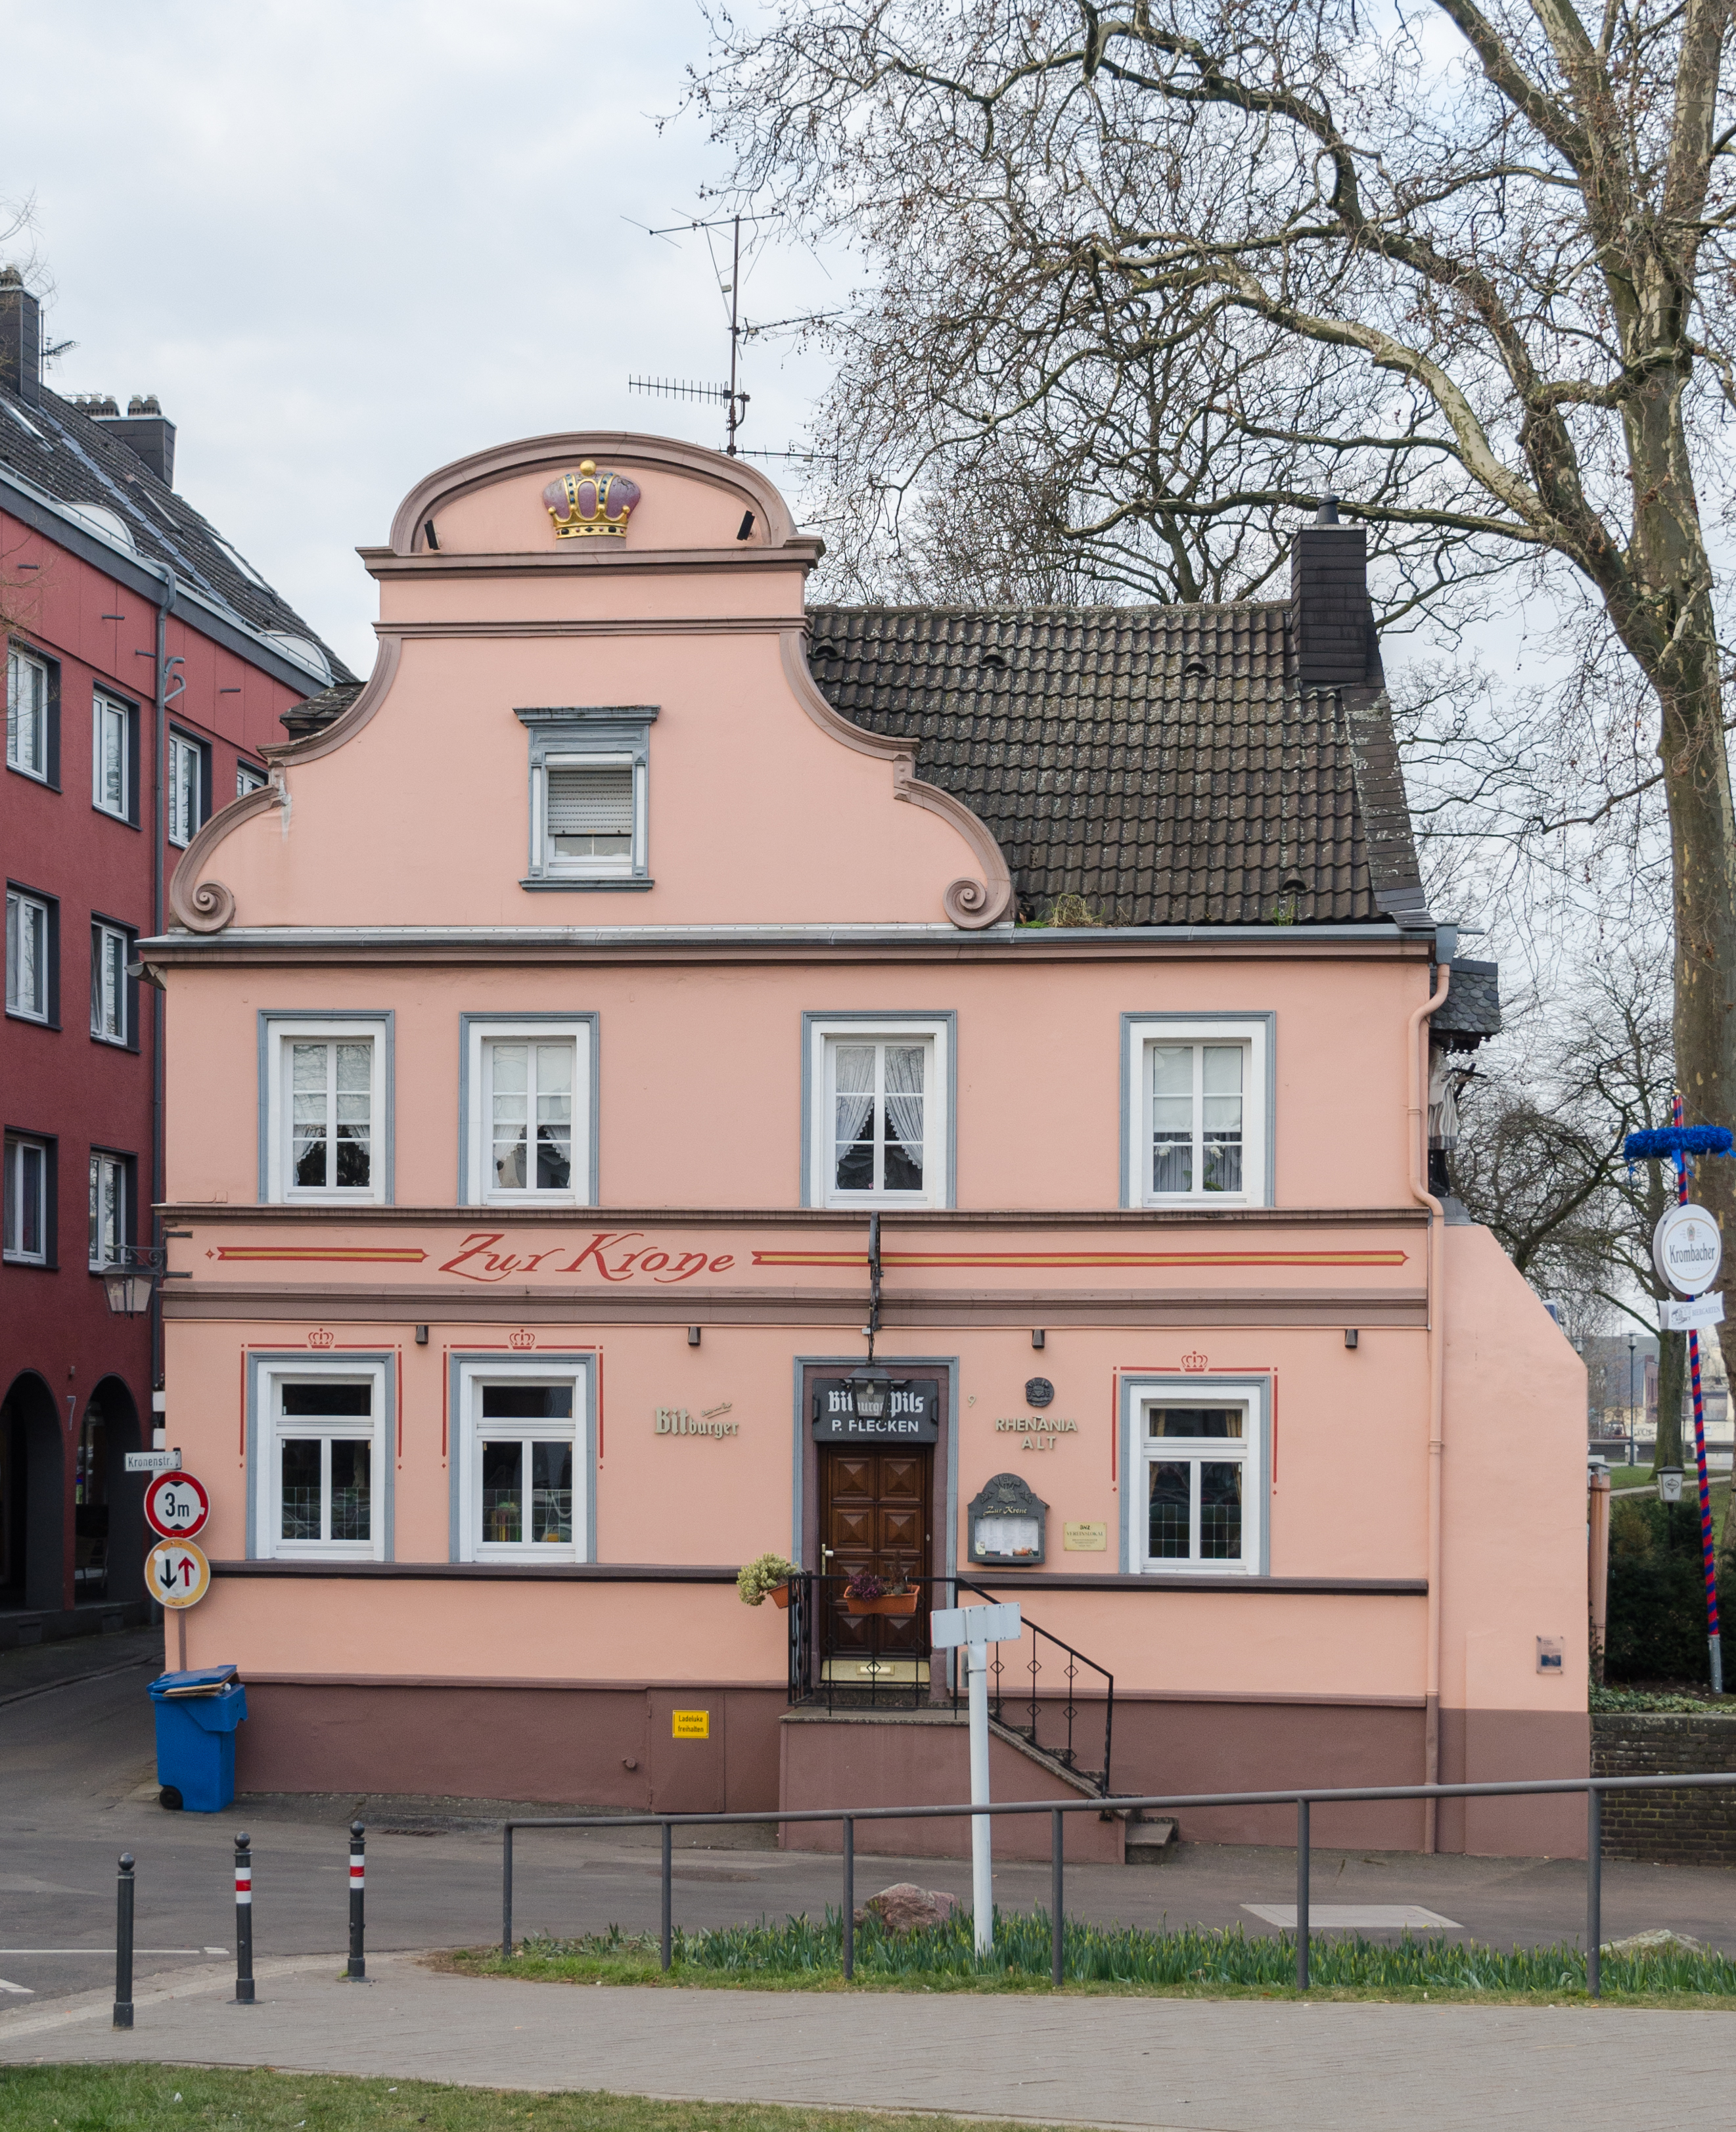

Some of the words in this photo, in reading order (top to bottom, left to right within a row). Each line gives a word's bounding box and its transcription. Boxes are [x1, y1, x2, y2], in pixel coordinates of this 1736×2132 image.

[438, 1233, 565, 1282] Zur
[555, 1233, 735, 1283] Krone
[1670, 1242, 1715, 1264] Krombacher
[890, 1391, 925, 1418] Pils
[967, 1394, 977, 1407] 9
[66, 1395, 77, 1431] 7
[654, 1407, 739, 1439] Bitburger
[832, 1419, 842, 1432] P.
[849, 1419, 919, 1433] FLECKEN
[995, 1417, 1078, 1432] RHENANIA
[1021, 1436, 1057, 1450] ALT
[128, 1456, 173, 1468] Kronenstr.
[983, 1505, 1002, 1516] Zur
[1003, 1506, 1027, 1514] Krone
